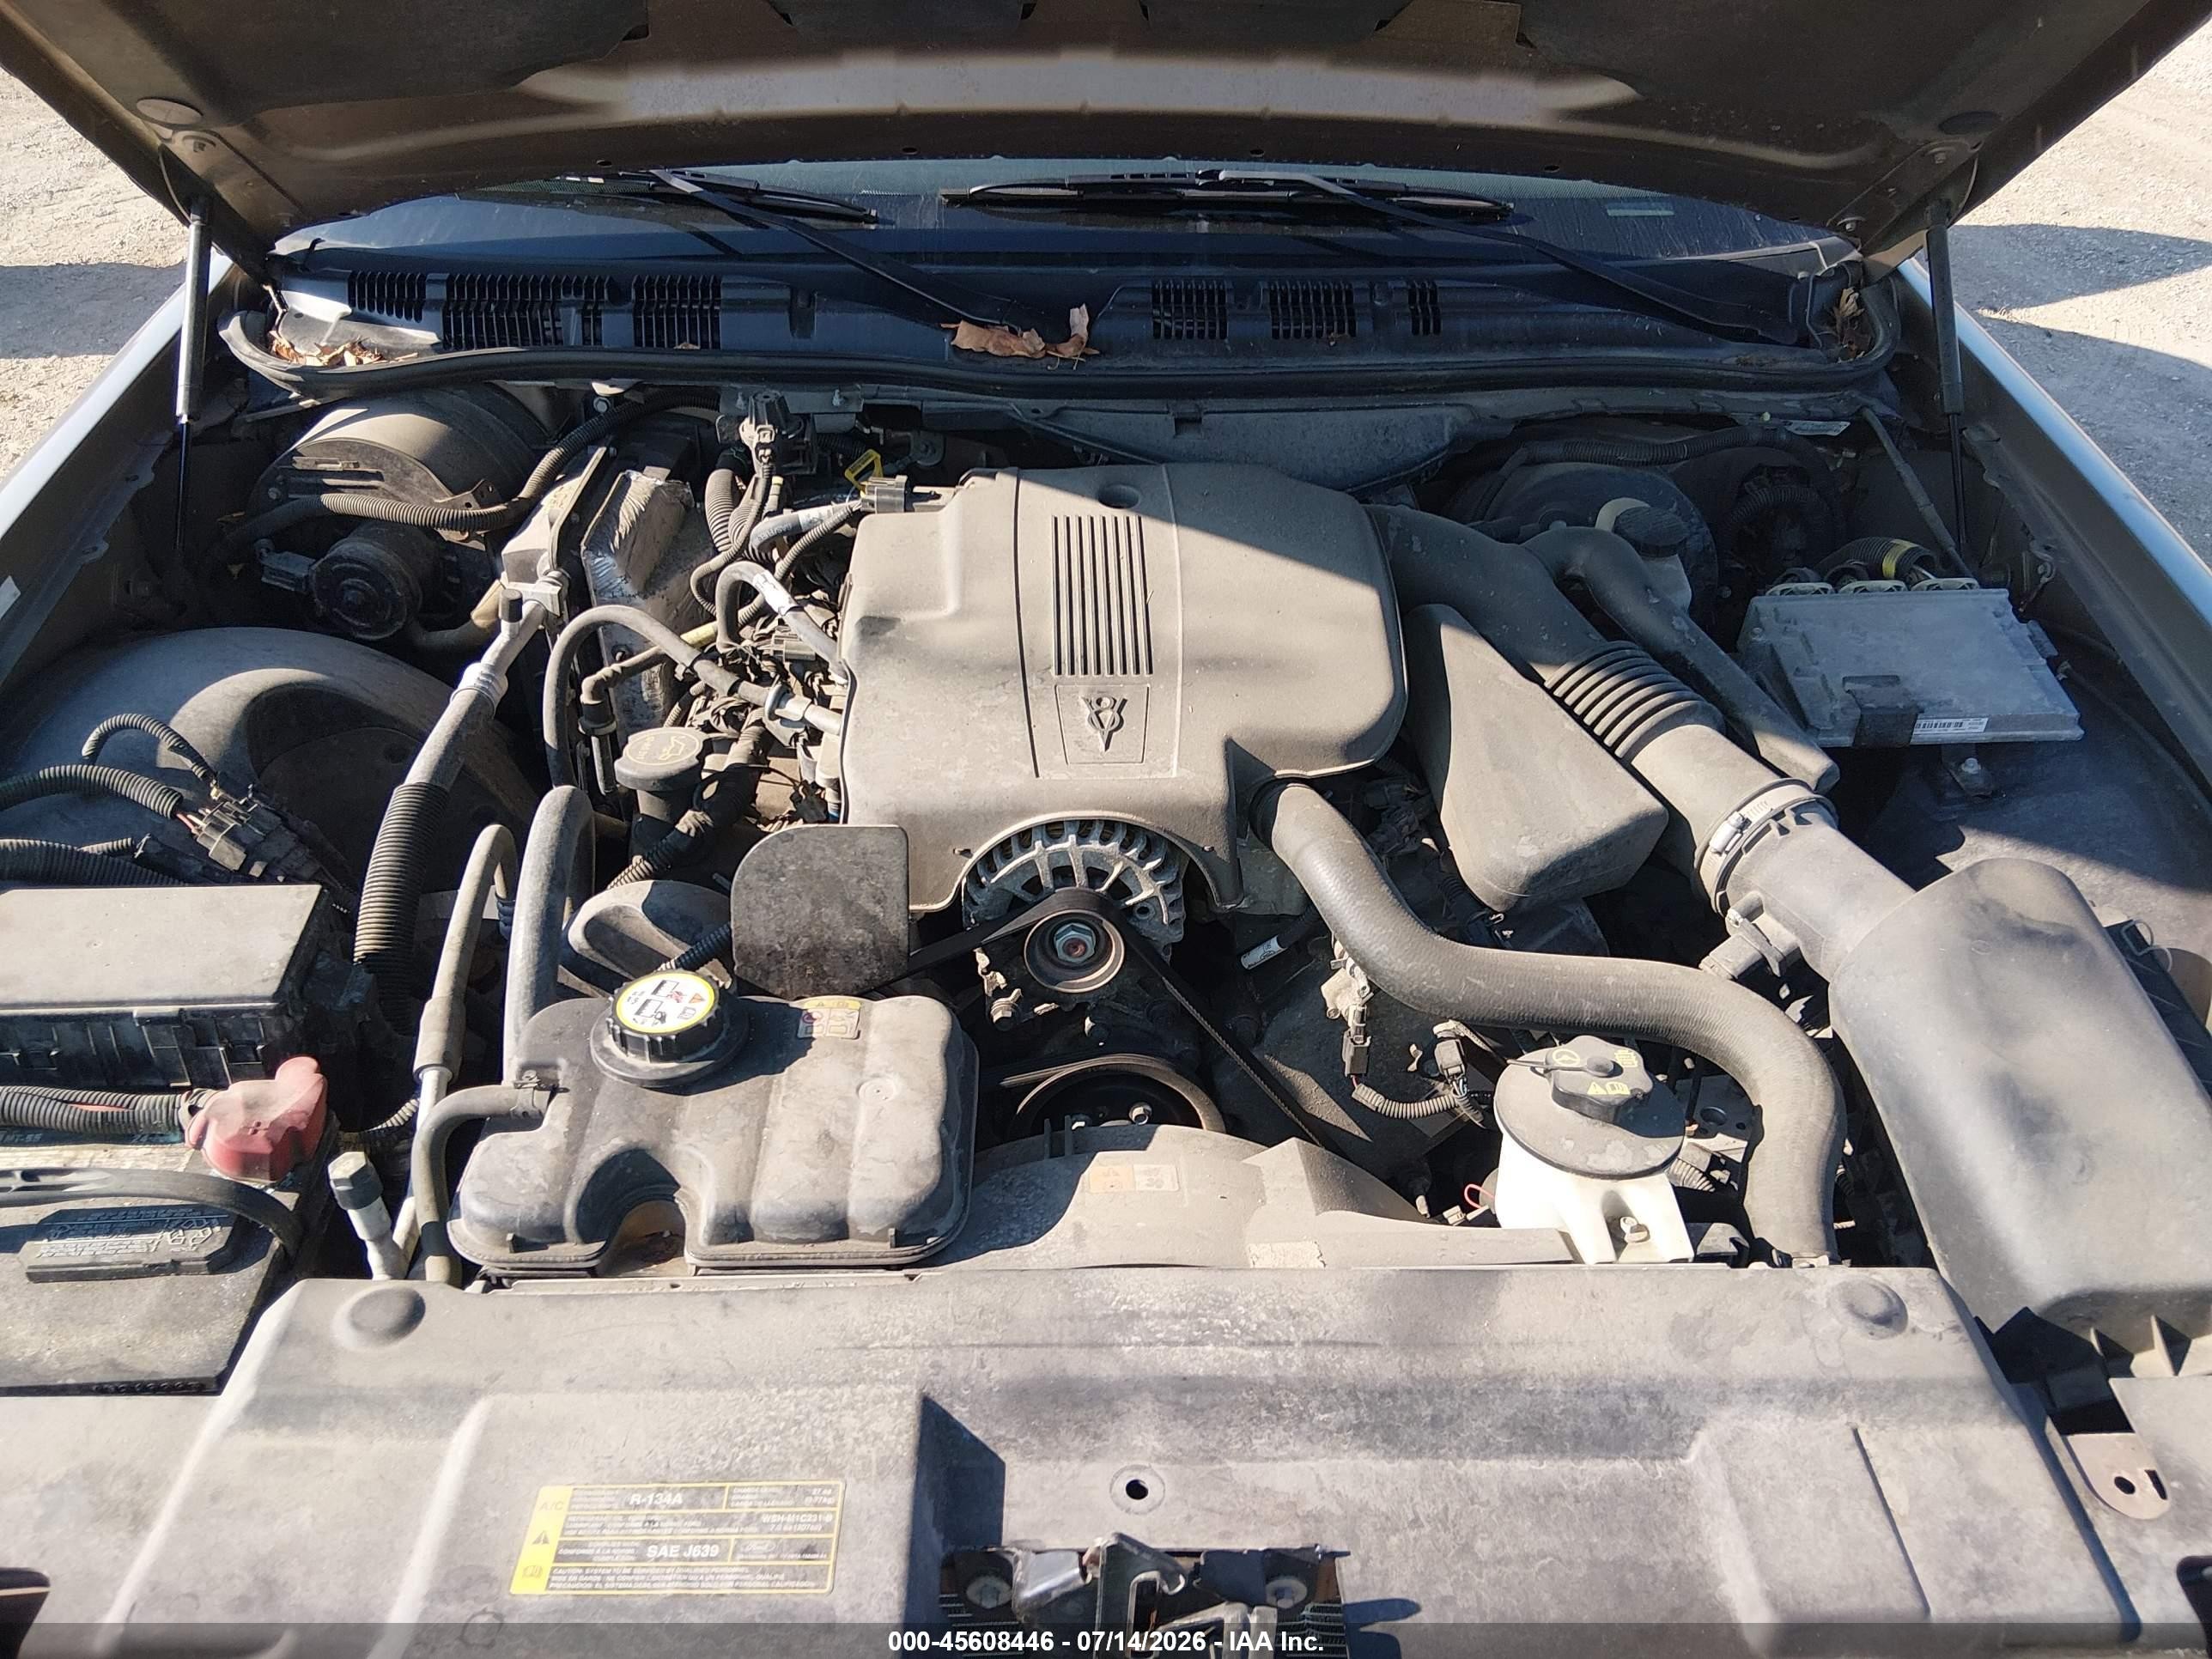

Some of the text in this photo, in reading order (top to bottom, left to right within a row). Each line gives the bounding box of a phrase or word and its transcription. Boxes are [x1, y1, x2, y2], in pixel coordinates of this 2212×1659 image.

[540, 1500, 565, 1510] A/C
[629, 1493, 684, 1505] R-134A
[647, 1545, 680, 1557] SAE
[683, 1545, 720, 1557] J639
